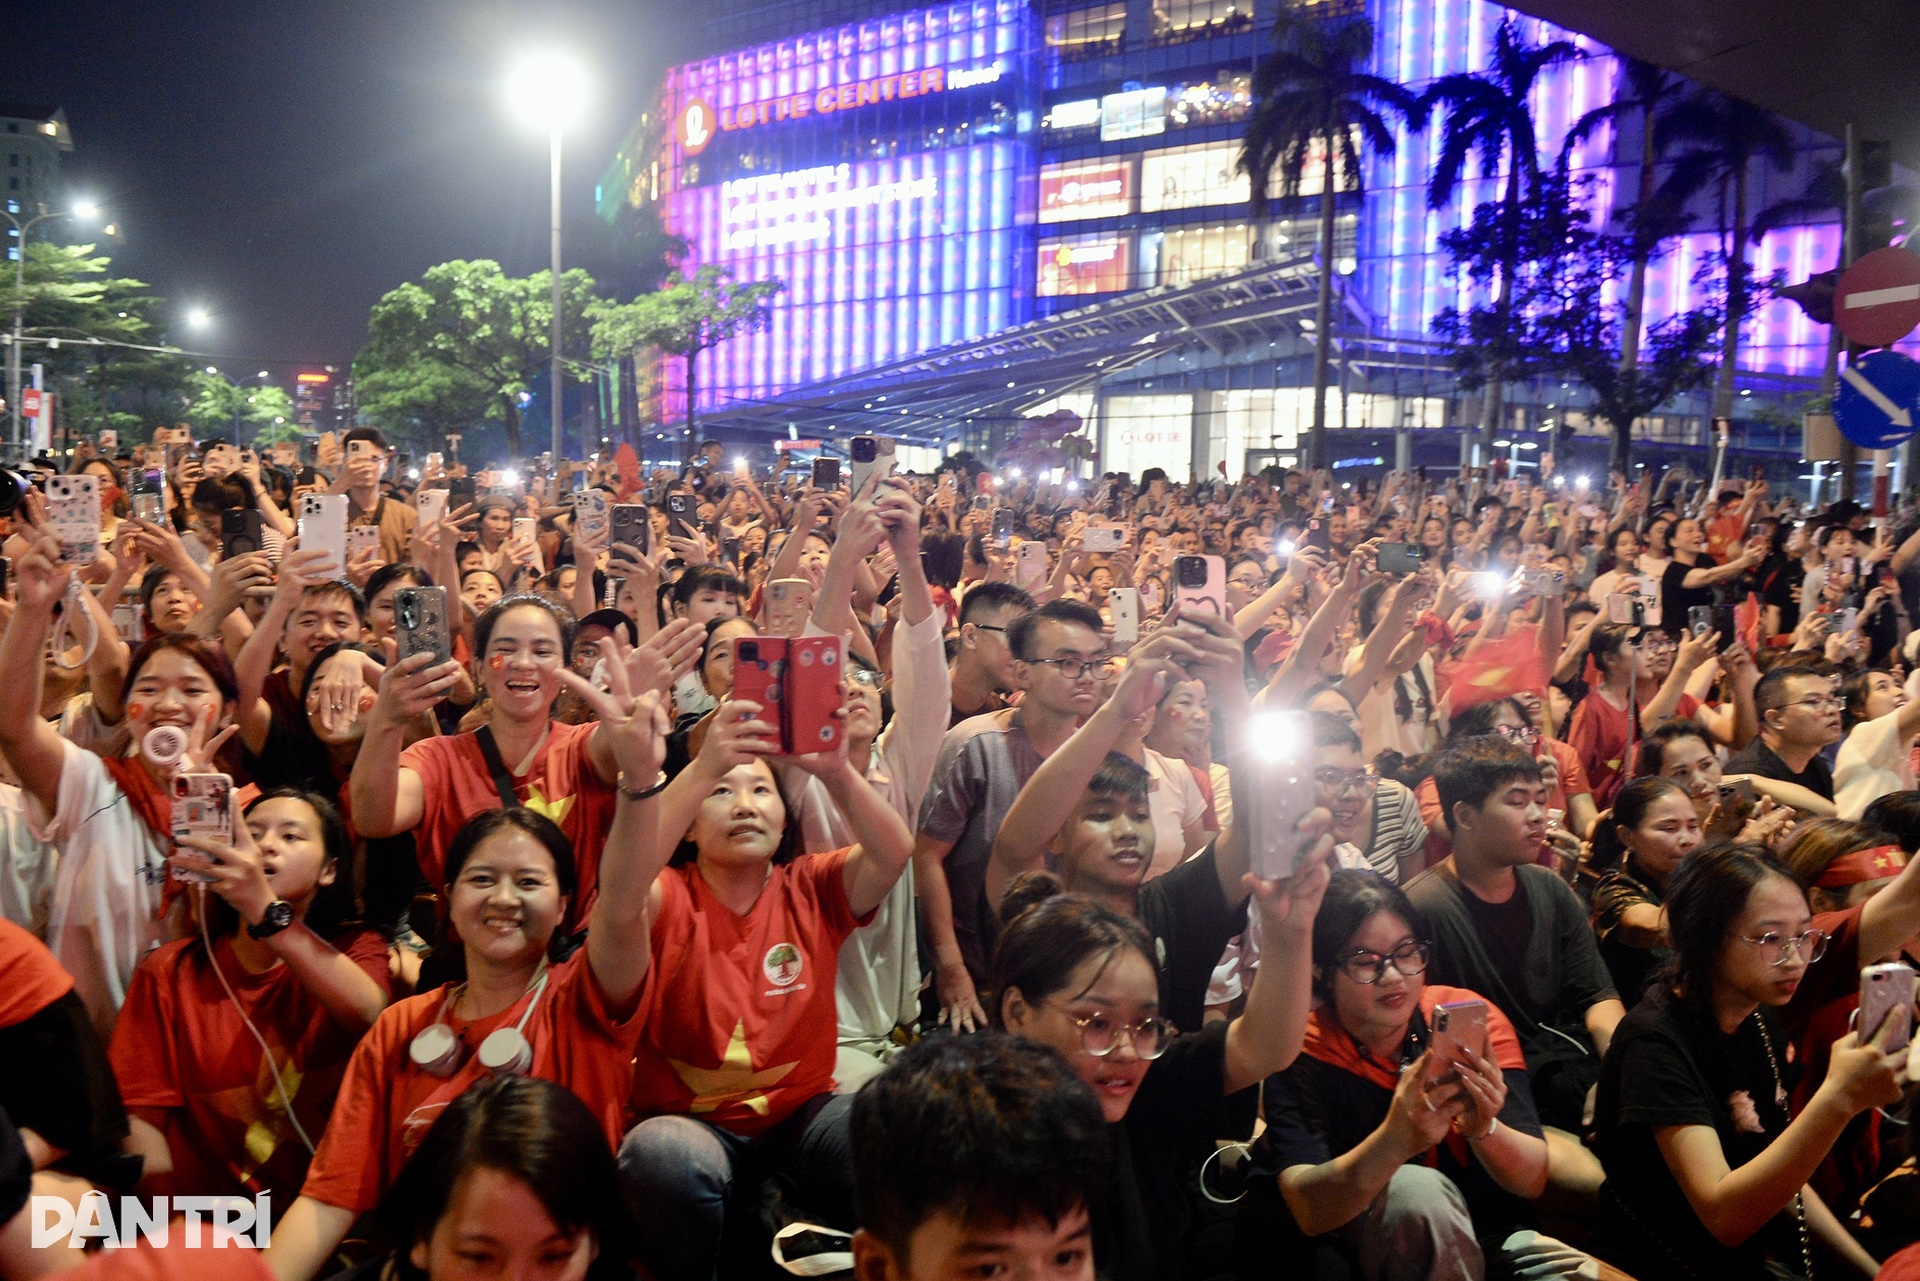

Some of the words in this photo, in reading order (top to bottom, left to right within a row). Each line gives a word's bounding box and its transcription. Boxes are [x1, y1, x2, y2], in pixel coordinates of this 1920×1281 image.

[721, 94, 812, 132] LOTTE
[814, 67, 944, 114] CENTER
[947, 60, 1001, 91] Hanoi
[1136, 432, 1182, 443] LOTTE
